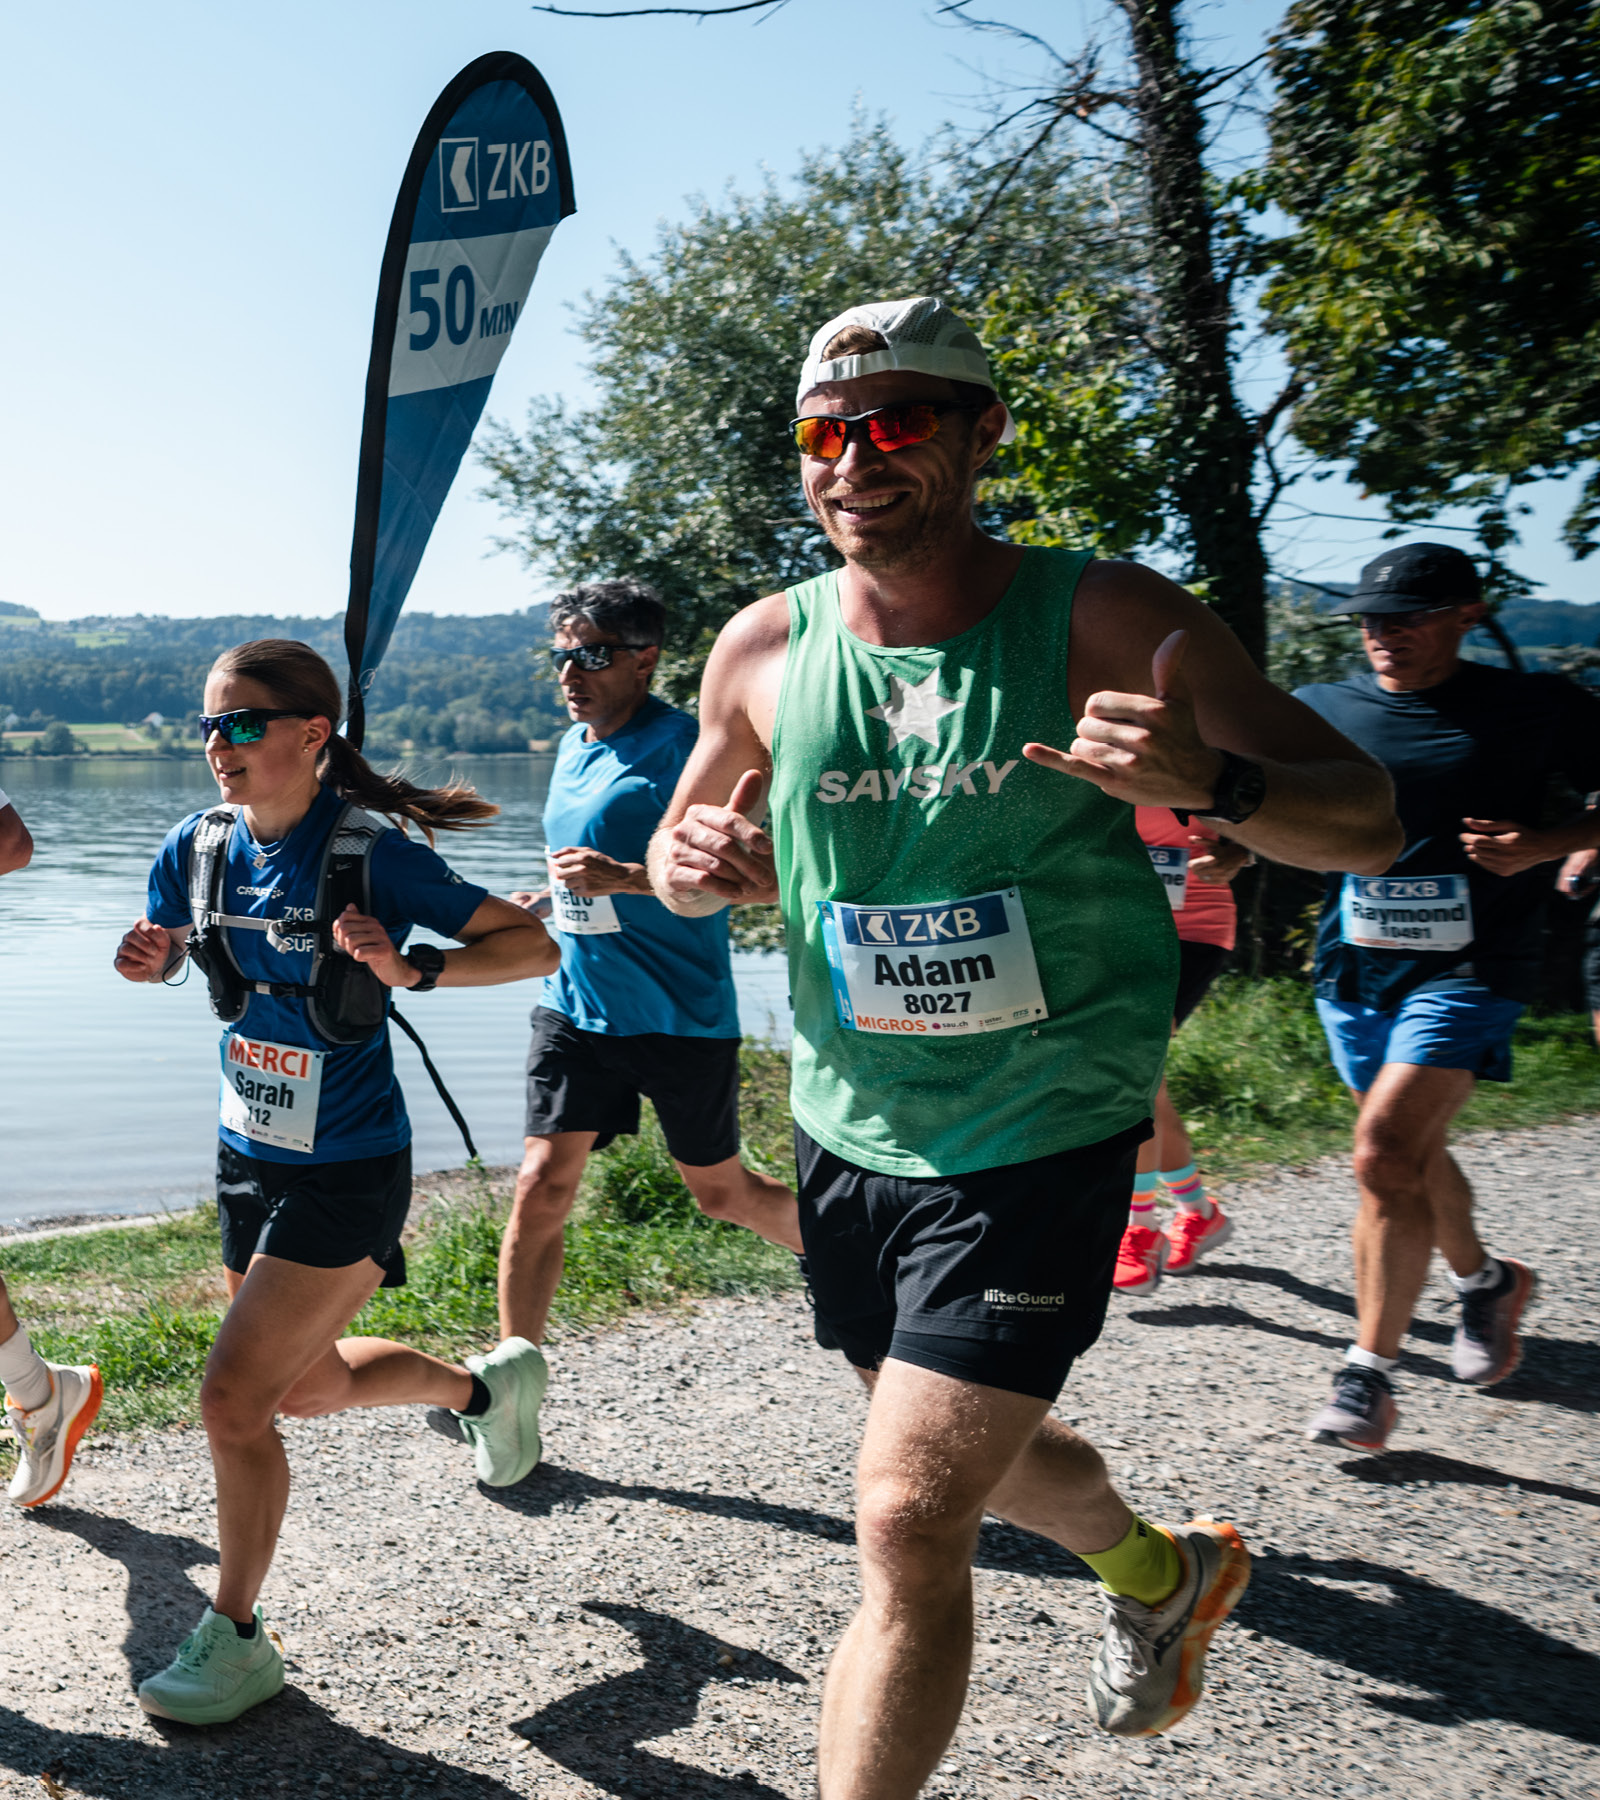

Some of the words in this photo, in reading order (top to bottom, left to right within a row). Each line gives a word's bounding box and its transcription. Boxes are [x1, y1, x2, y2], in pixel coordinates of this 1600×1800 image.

[487, 140, 551, 200] ZKB
[408, 264, 476, 351] 50
[480, 301, 519, 339] MIN
[815, 759, 1020, 804] SAYSKY
[1148, 849, 1170, 864] KB
[236, 885, 272, 897] CRAFT
[1157, 873, 1185, 886] ne
[1387, 881, 1440, 898] ZKB
[283, 906, 314, 922] ZKB
[899, 907, 981, 942] ZKB
[1351, 901, 1466, 925] Raymond
[874, 952, 996, 987] Adam
[903, 991, 972, 1016] 8027
[856, 1014, 927, 1032] MIGROS
[229, 1038, 309, 1078] MERCI
[235, 1070, 295, 1109] Sarah
[248, 1105, 271, 1127] 112
